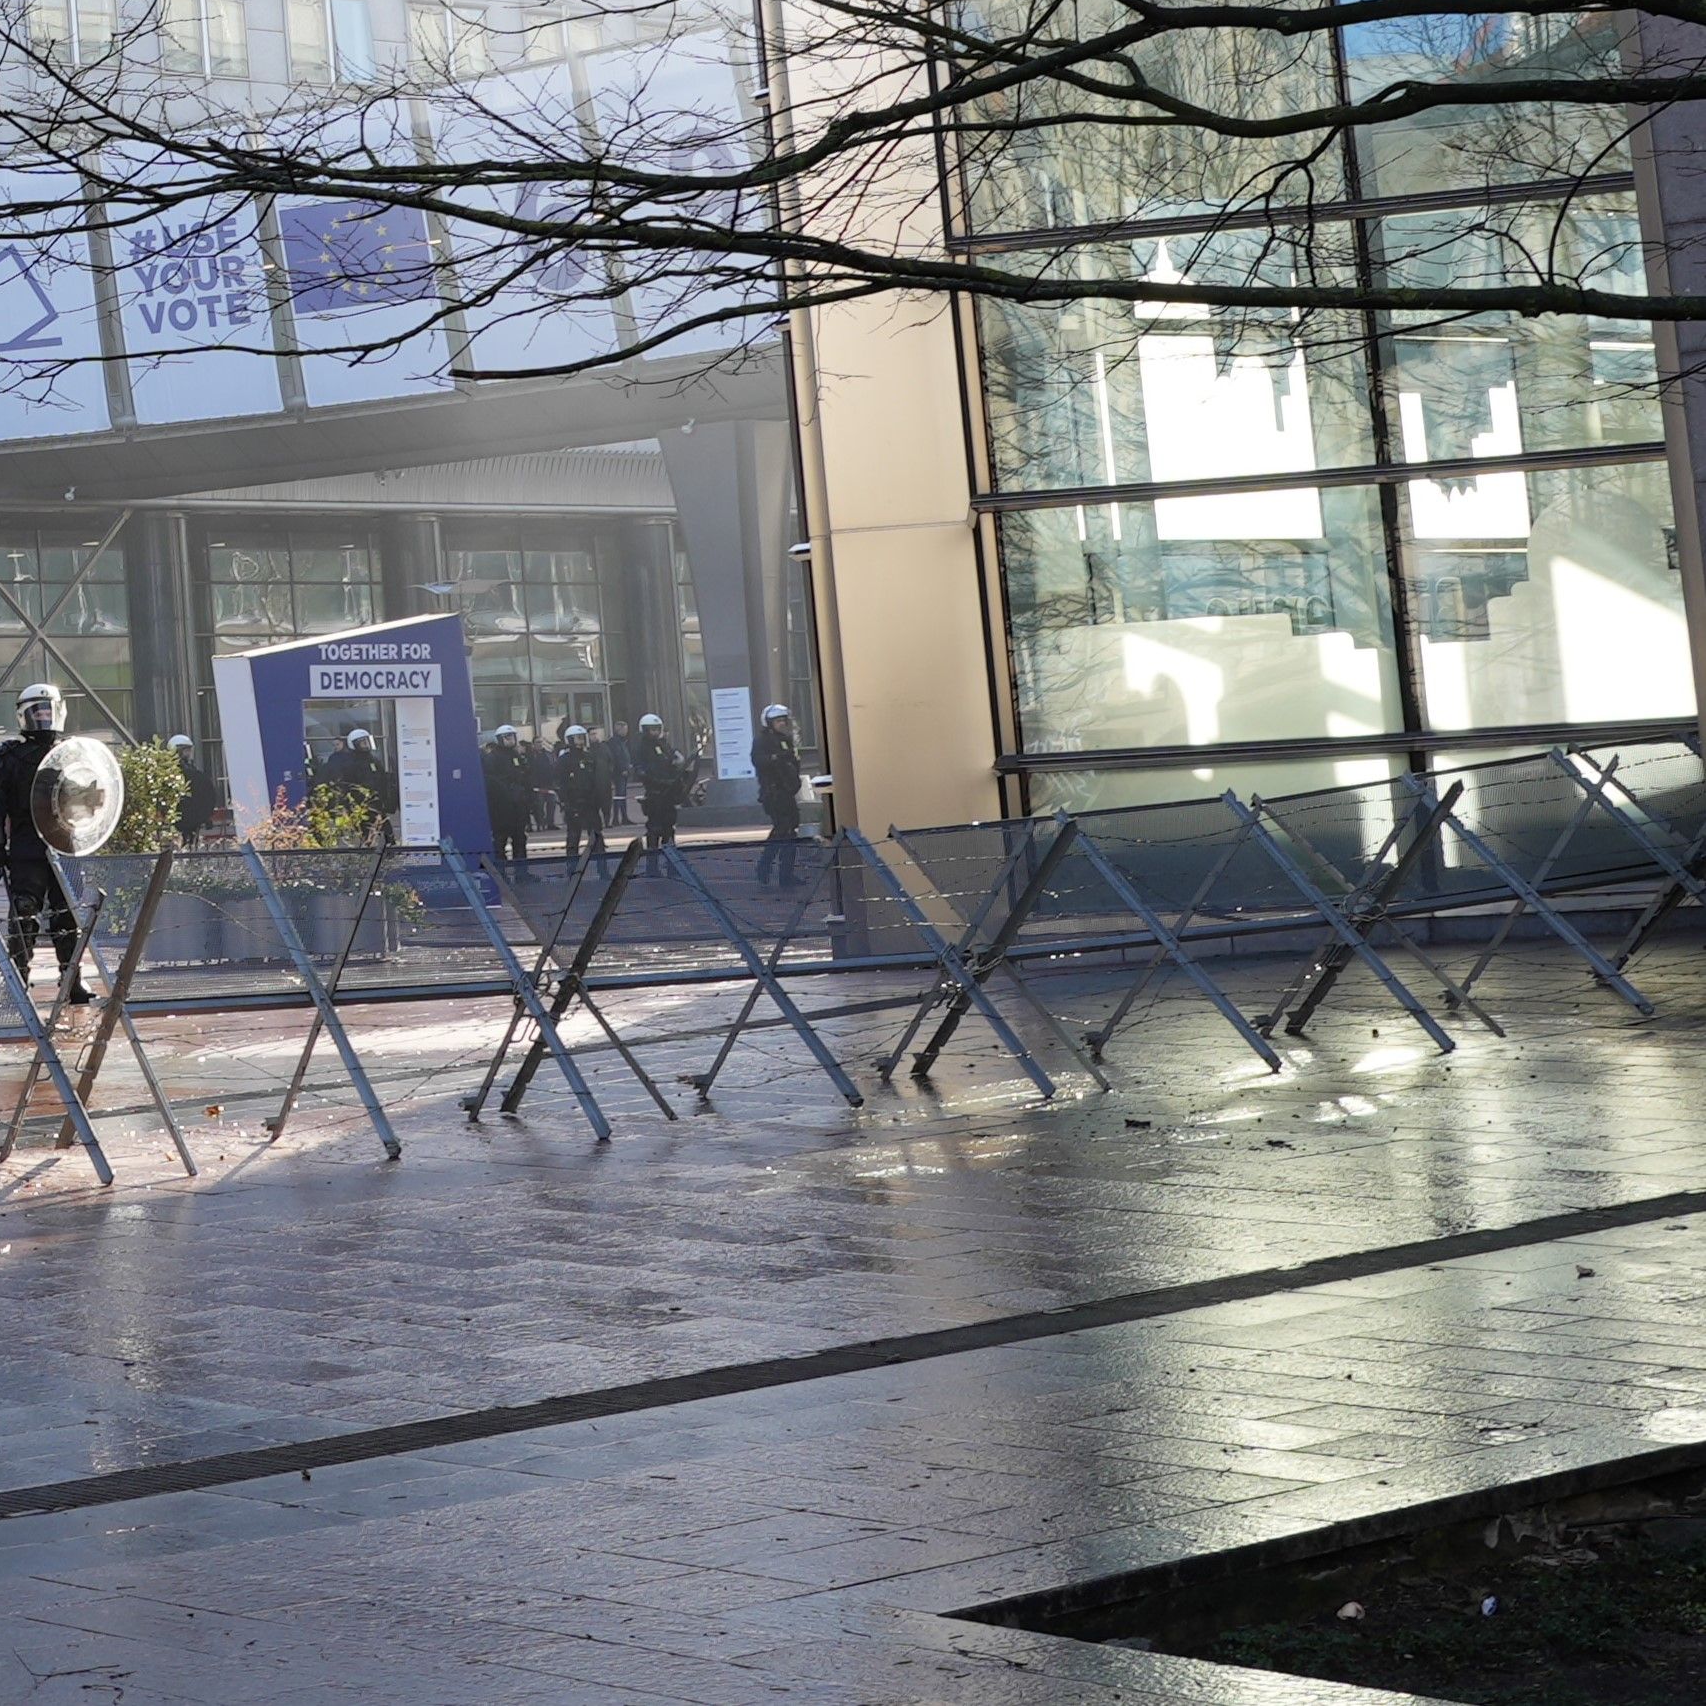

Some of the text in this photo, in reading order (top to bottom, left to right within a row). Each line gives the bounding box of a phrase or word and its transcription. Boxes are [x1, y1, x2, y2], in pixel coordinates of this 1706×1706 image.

[129, 217, 240, 260] #USE
[133, 255, 248, 298] YOUR
[138, 291, 252, 335] VOTE
[318, 643, 432, 661] TOGETHER FOR
[320, 669, 432, 691] DEMOCRACY
